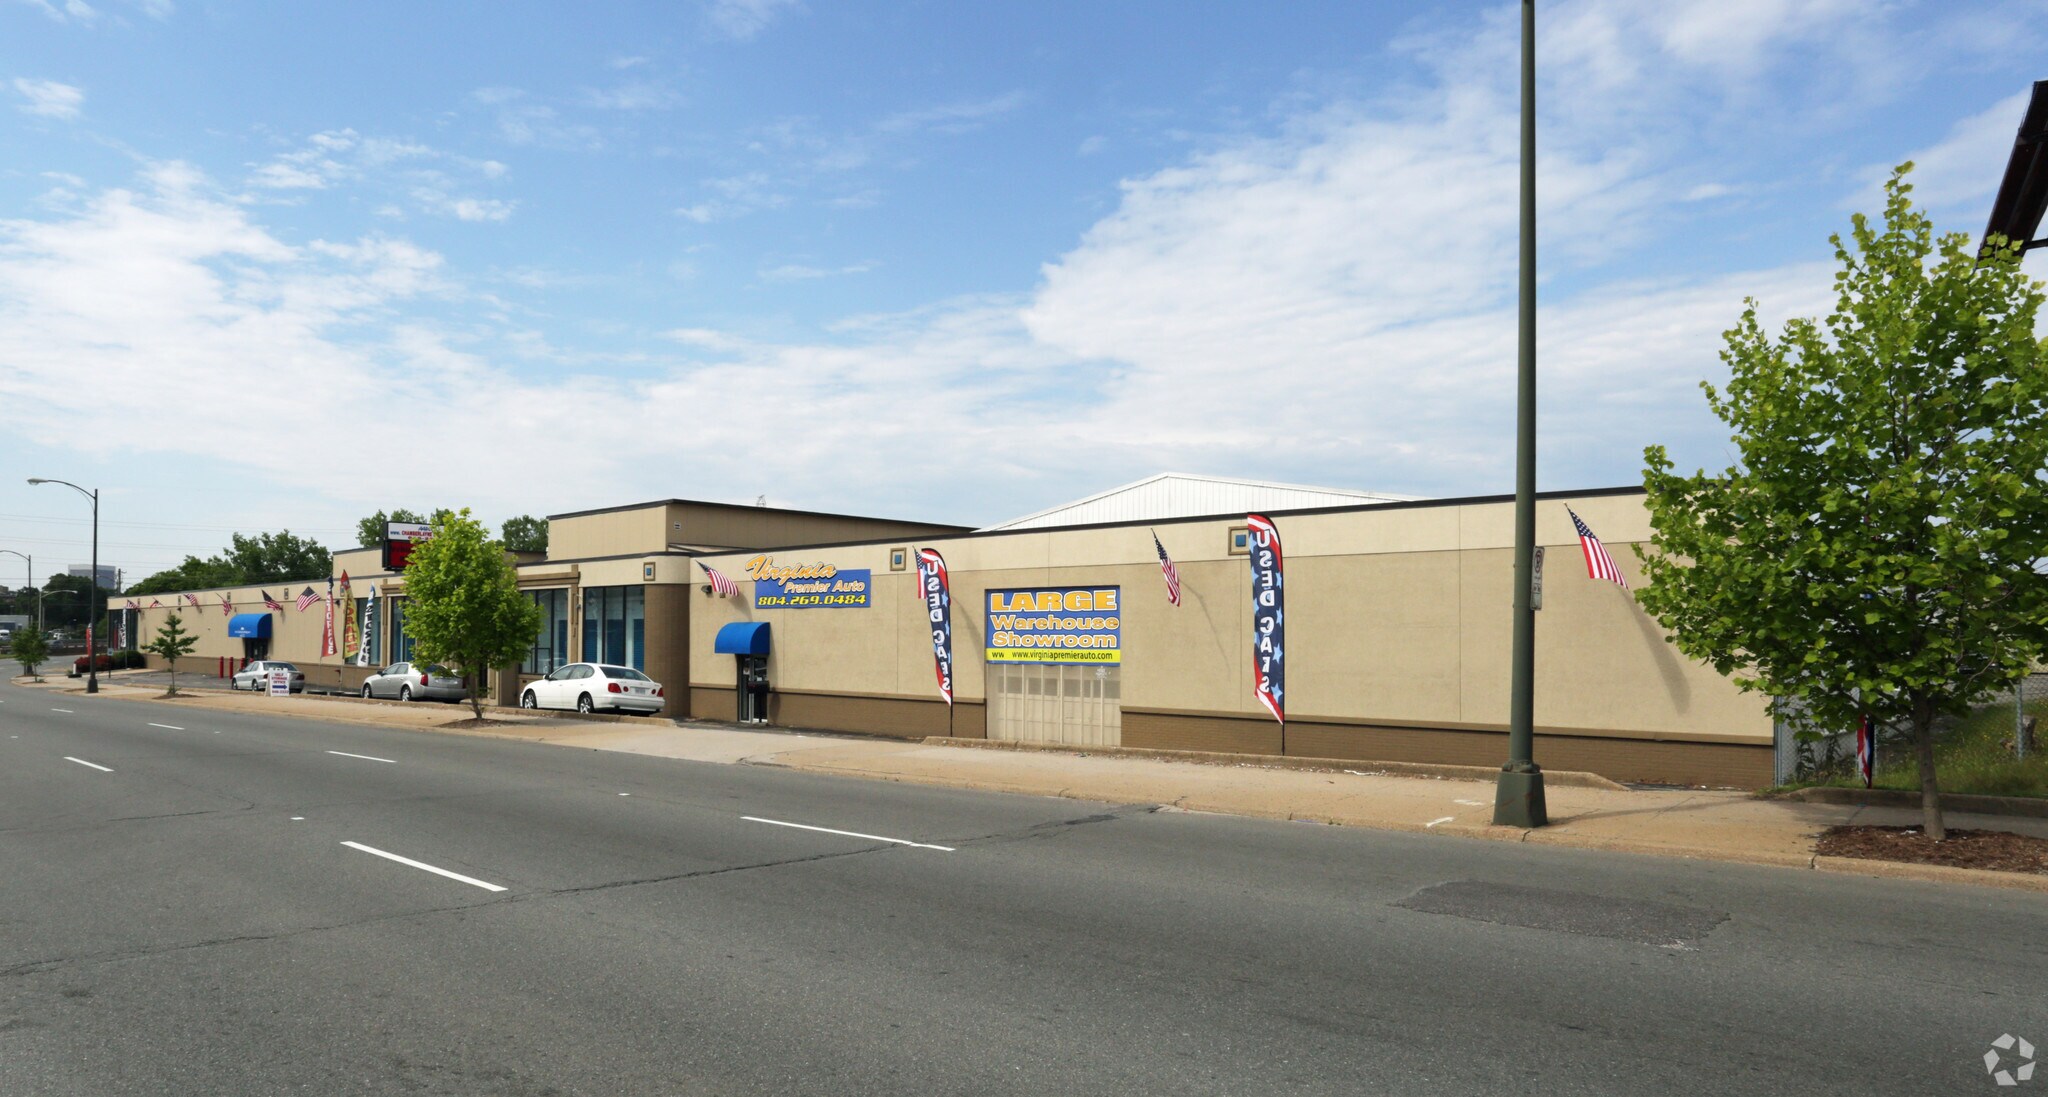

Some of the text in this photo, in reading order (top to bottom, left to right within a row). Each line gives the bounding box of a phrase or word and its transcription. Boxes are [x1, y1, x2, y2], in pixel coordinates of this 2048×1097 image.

[745, 554, 837, 586] Virginia
[783, 580, 866, 594] Premier Auto
[758, 595, 866, 606] 804.269.0484
[990, 590, 1117, 612] LARGE
[990, 614, 1120, 630] Warehouse
[992, 631, 1117, 648] Showroom
[1012, 650, 1113, 661] www.virginiapremierauto.com
